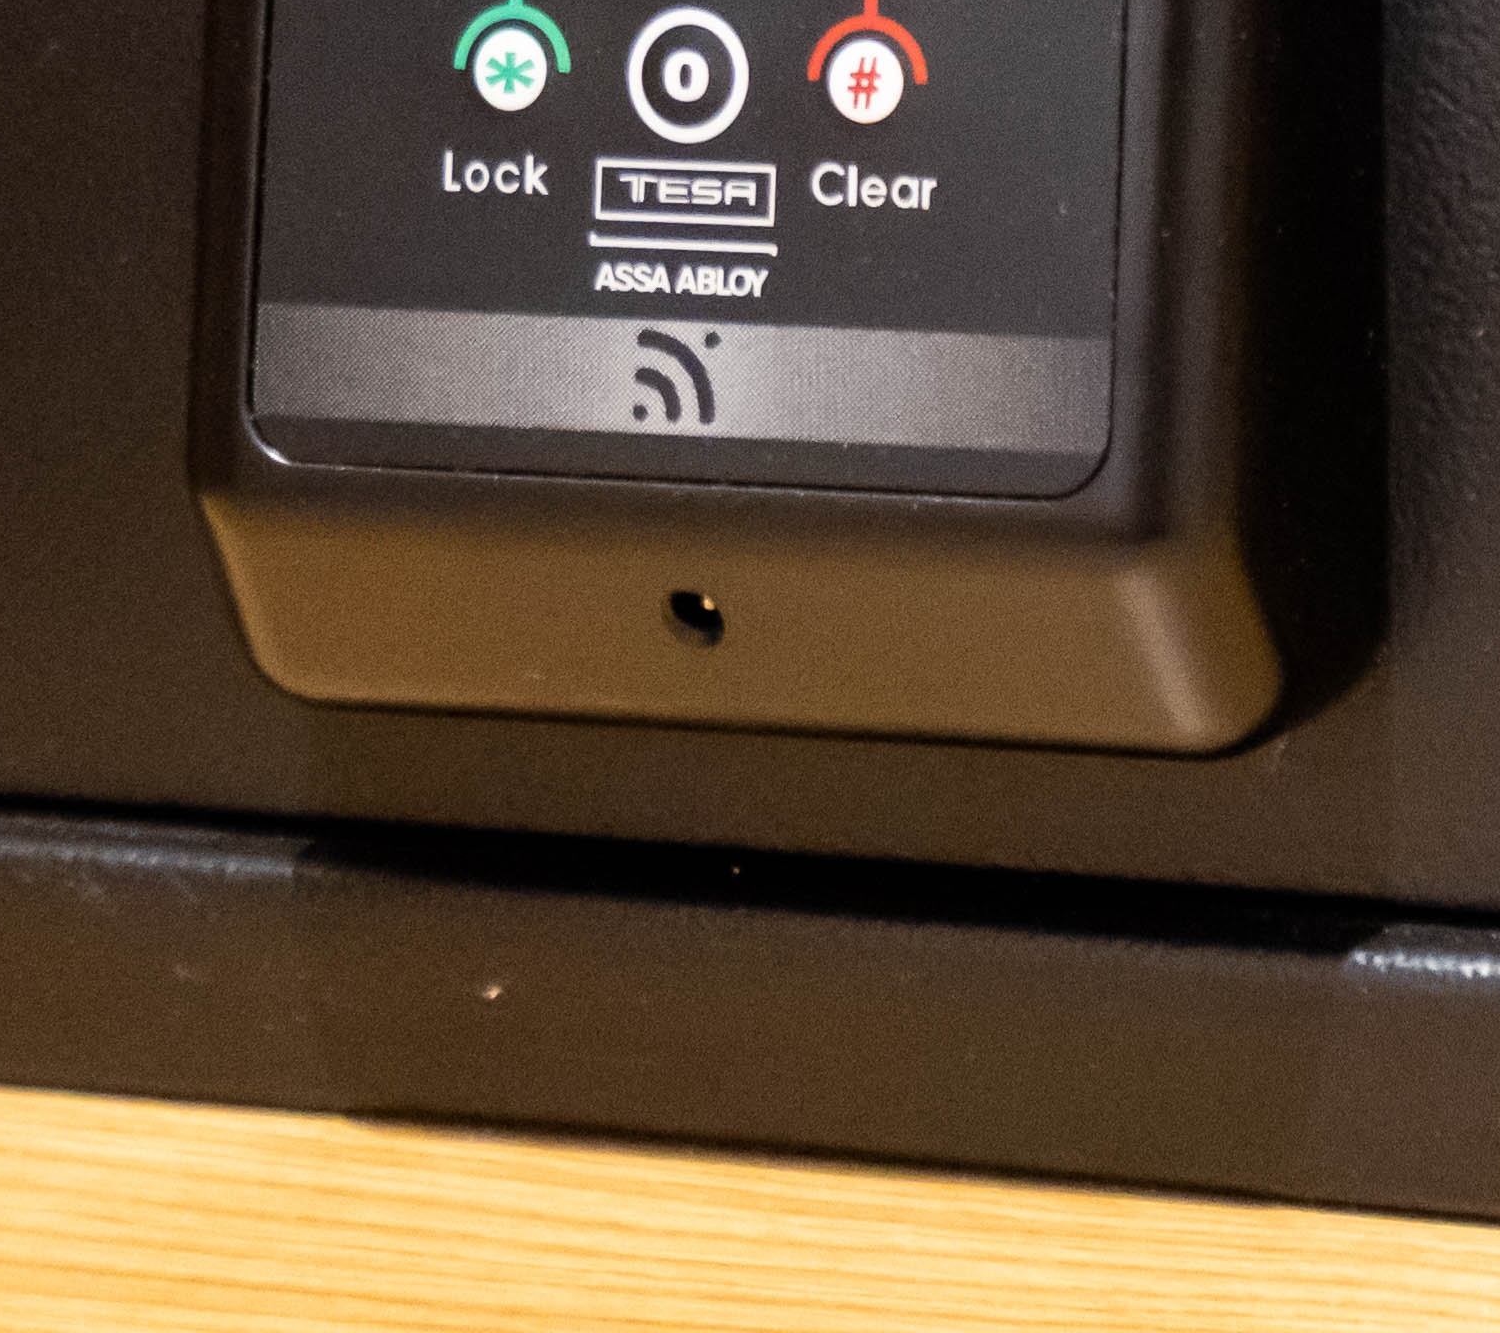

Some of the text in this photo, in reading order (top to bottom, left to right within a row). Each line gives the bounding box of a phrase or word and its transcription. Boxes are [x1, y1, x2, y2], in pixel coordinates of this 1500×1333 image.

[662, 48, 710, 103] 0
[442, 149, 549, 196] Lock
[618, 172, 757, 207] TESA
[810, 161, 938, 211] Clear
[593, 261, 769, 298] ASSA ABLOY
